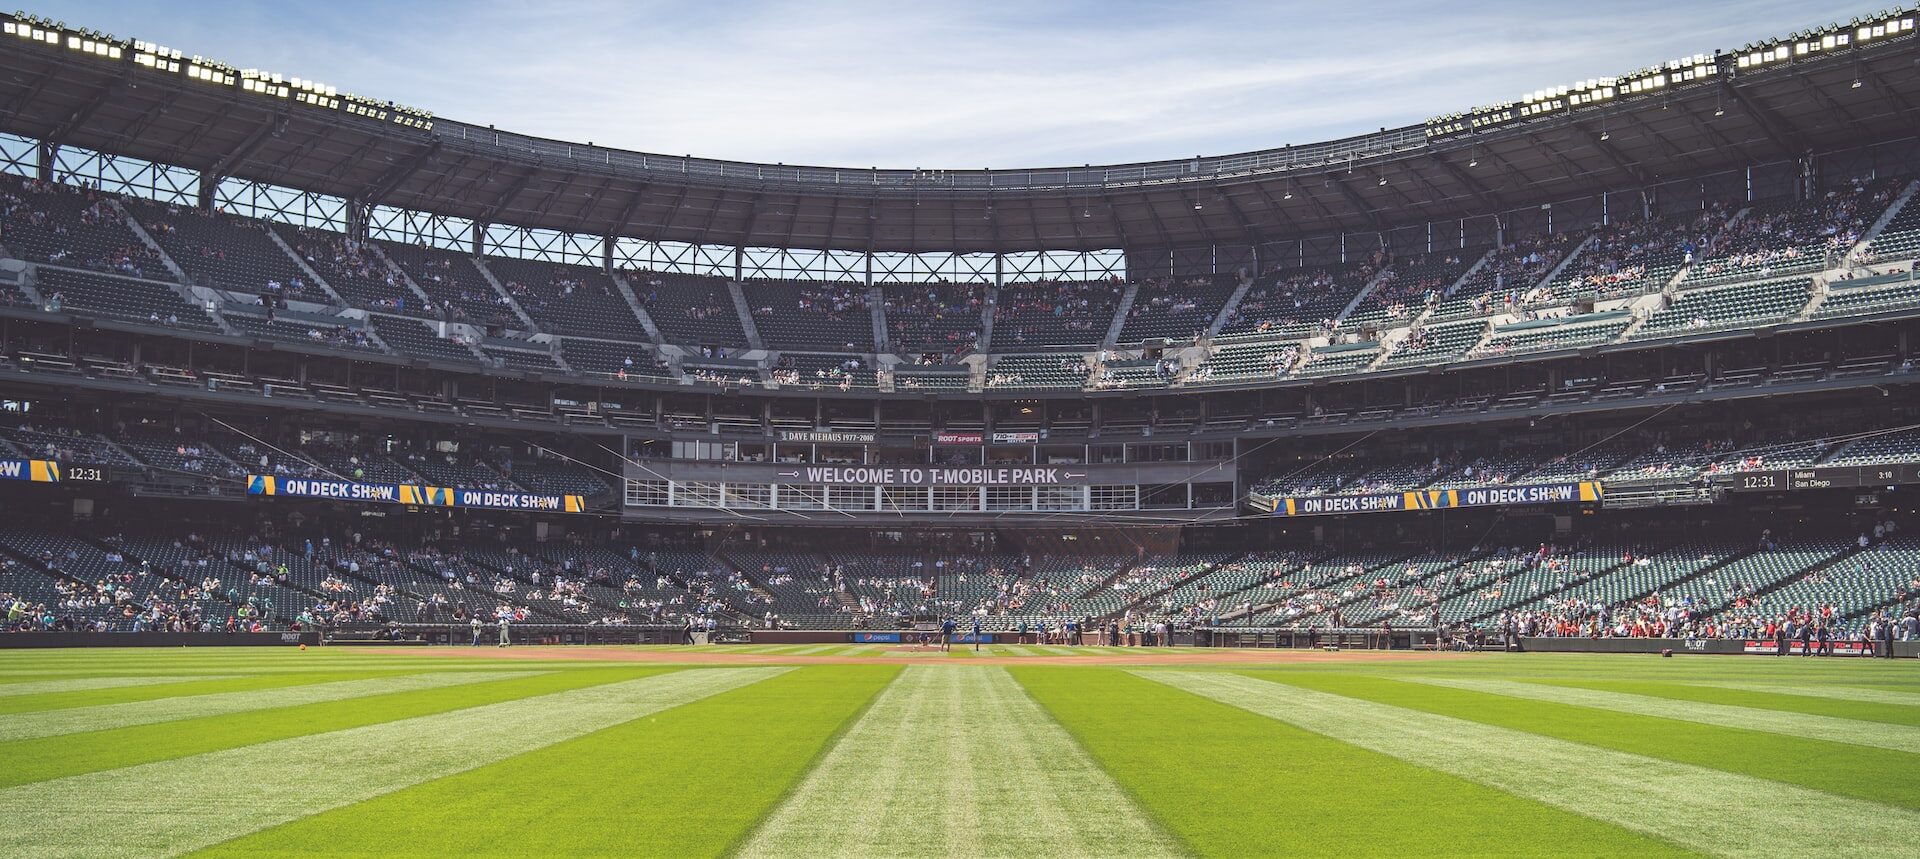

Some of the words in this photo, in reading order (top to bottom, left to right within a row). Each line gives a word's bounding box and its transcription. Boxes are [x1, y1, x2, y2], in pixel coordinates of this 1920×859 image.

[789, 432, 808, 441] DAVE
[810, 432, 841, 441] NIEHAUS
[843, 434, 874, 442] 1977-2010
[0, 461, 21, 478] W
[69, 468, 102, 481] 12:31
[806, 467, 894, 484] WELCOME
[900, 468, 923, 484] TO
[930, 468, 1008, 484] T-MOBILE
[1012, 468, 1059, 483] PARK
[1794, 471, 1816, 479] Miami
[286, 480, 307, 496] ON
[310, 482, 349, 498] DECK
[1743, 475, 1776, 489] 12:31
[1795, 480, 1810, 488] San
[1811, 480, 1831, 489] Diego
[463, 491, 481, 506] ON
[484, 493, 518, 508] DECK
[1467, 490, 1487, 504] ON
[1490, 488, 1526, 503] DECK
[1304, 500, 1322, 512] ON
[1325, 498, 1359, 511] DECK
